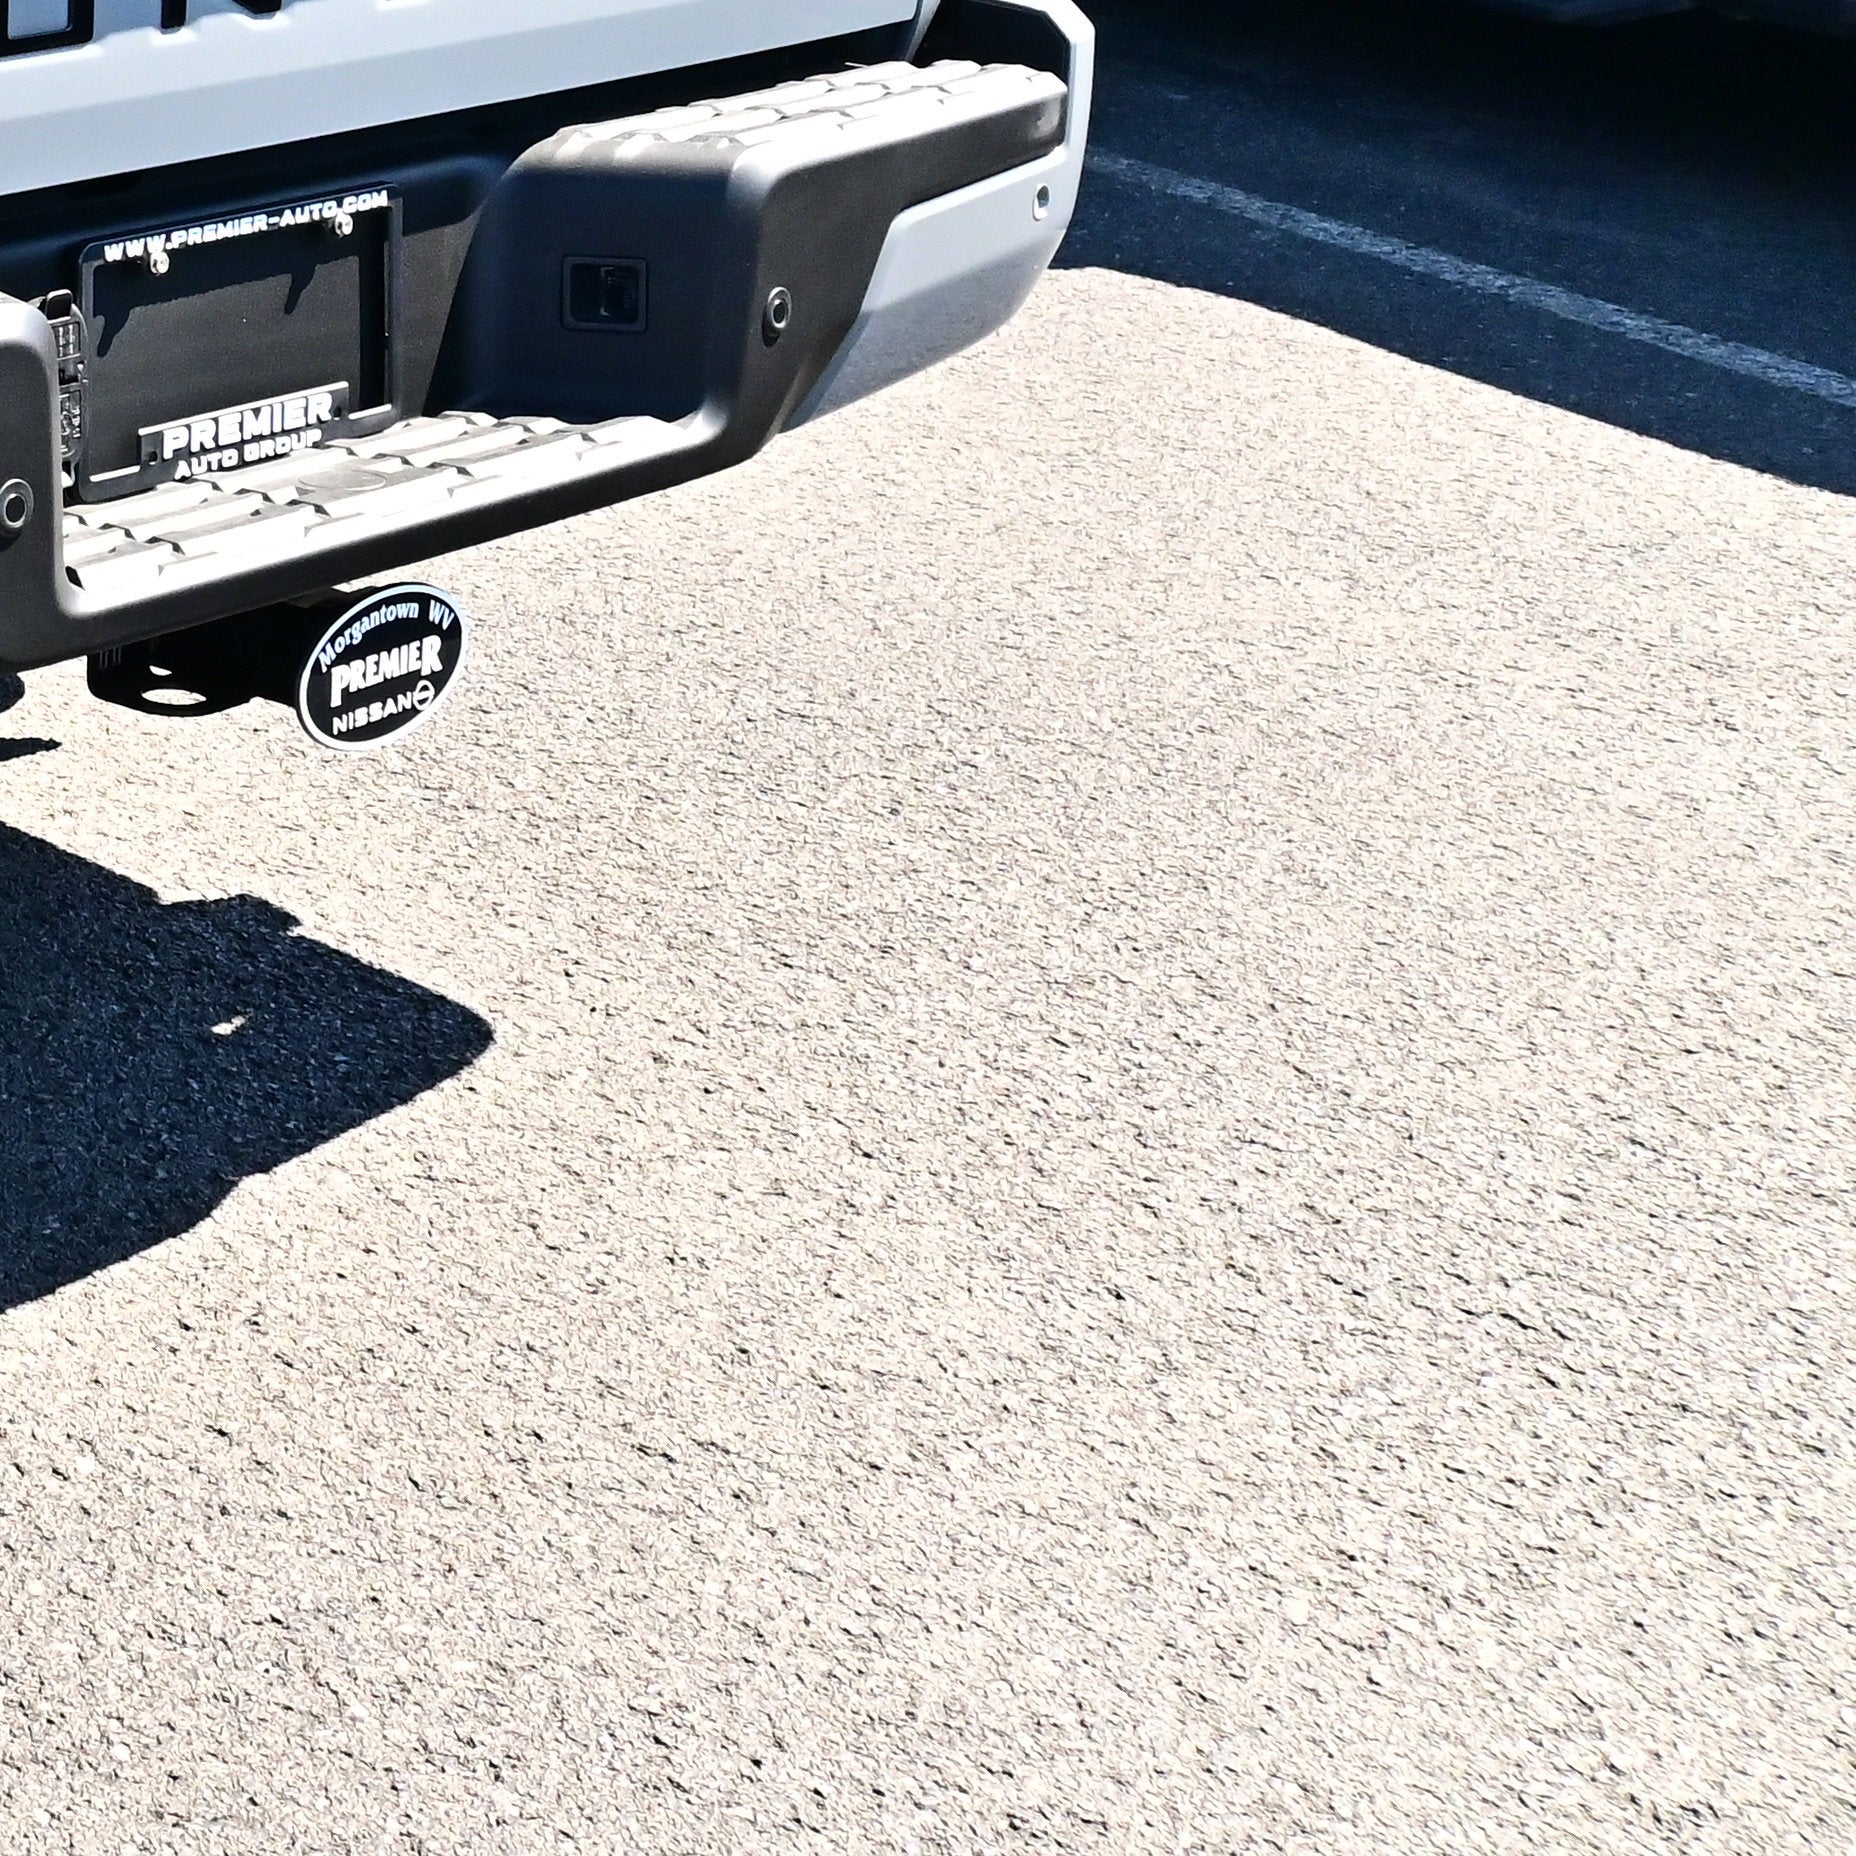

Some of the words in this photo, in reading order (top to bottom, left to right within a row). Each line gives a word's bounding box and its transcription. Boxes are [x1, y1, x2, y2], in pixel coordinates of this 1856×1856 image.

[103, 189, 389, 263] WWW.PREMIER-AUTO.COM
[161, 392, 334, 461] PREMIER
[173, 447, 239, 481] AUTO
[242, 427, 324, 464] GROUP
[316, 601, 420, 674] Morgantown
[428, 598, 455, 631] WV
[329, 634, 444, 709] PREMIER
[331, 690, 414, 736] NISSAN
